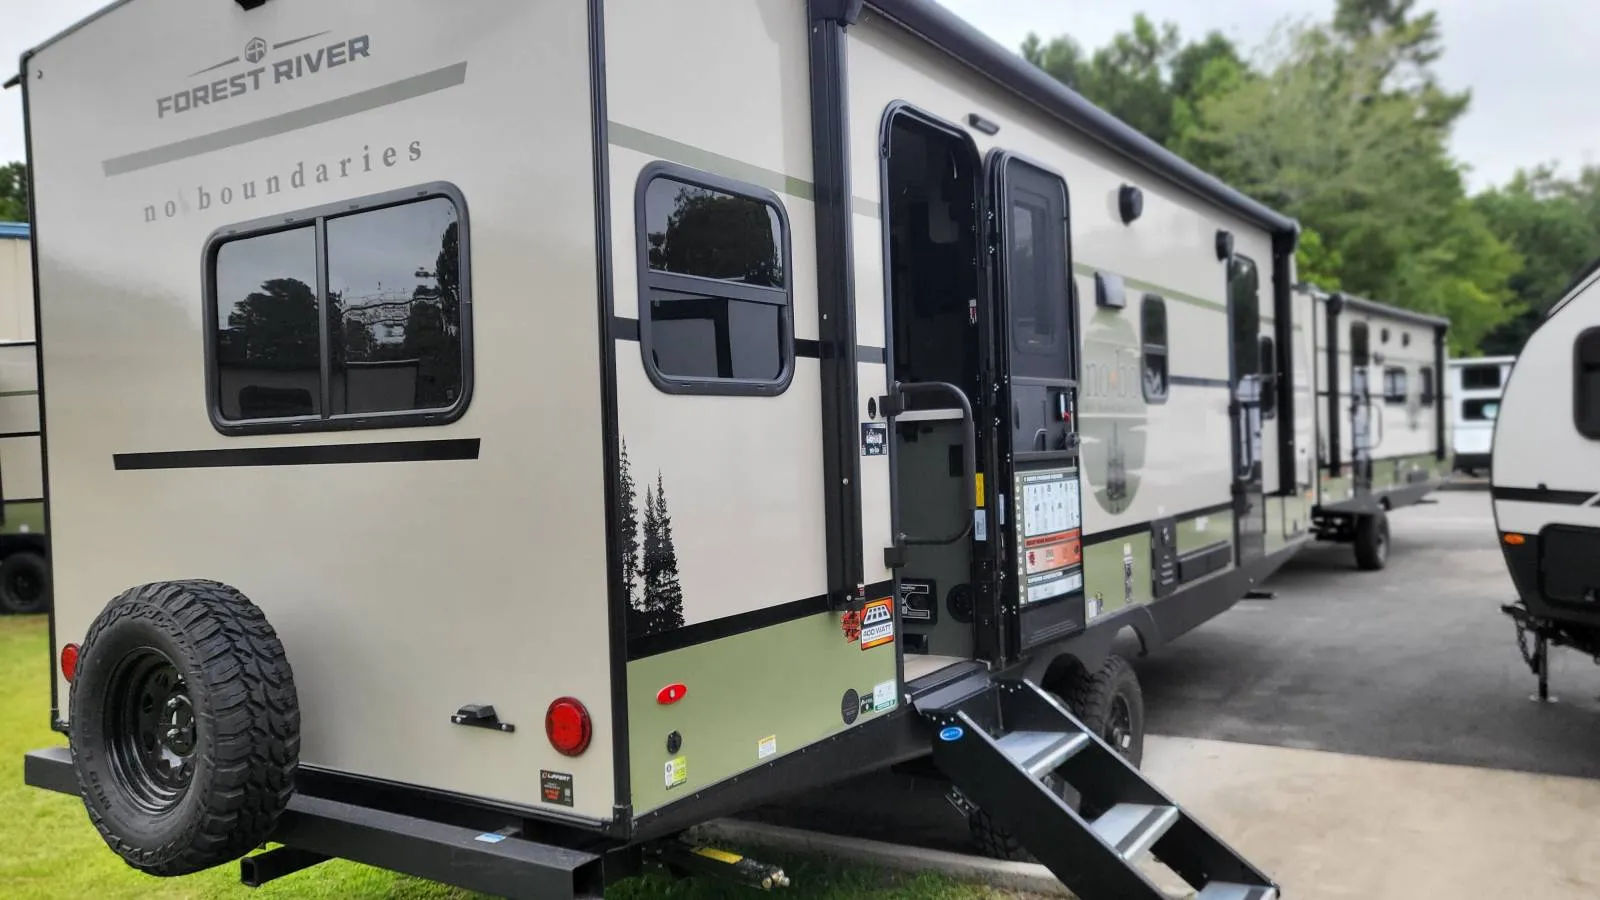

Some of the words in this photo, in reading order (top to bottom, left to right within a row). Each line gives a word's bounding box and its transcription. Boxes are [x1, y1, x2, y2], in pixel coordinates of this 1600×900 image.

[156, 67, 265, 118] FOREST
[272, 35, 371, 84] RIVER
[144, 200, 177, 223] no
[200, 140, 422, 211] boundaries
[876, 624, 891, 634] WATT
